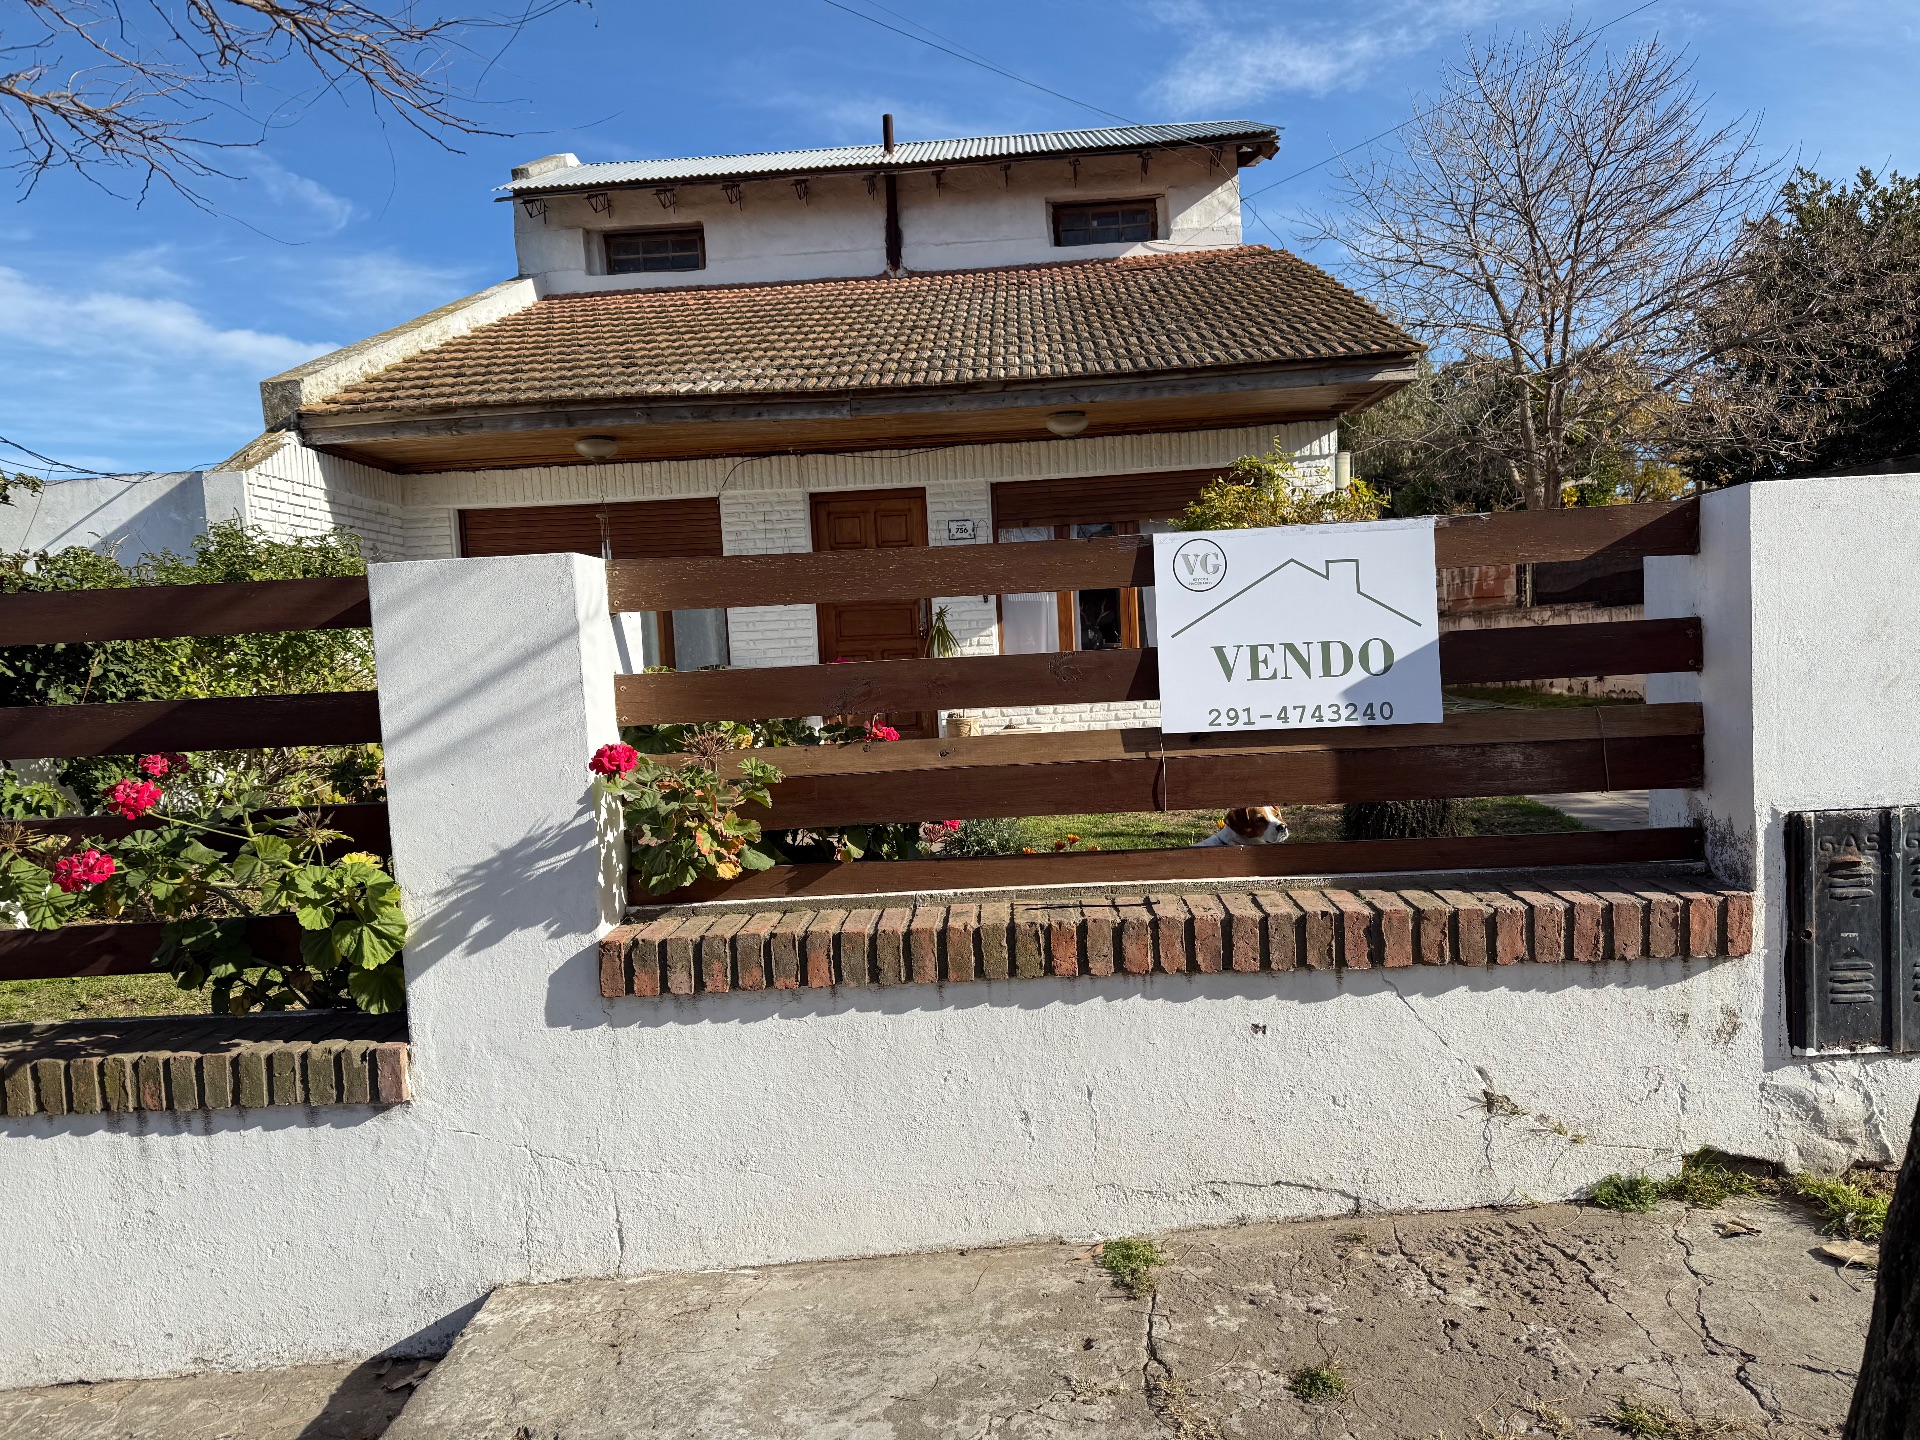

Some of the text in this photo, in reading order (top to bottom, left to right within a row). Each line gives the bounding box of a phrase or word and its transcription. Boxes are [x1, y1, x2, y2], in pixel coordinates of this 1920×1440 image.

[1179, 552, 1221, 575] VG
[1210, 637, 1395, 683] VENDO
[1208, 701, 1395, 727] 291-4743240
[1817, 833, 1880, 852] GAS
